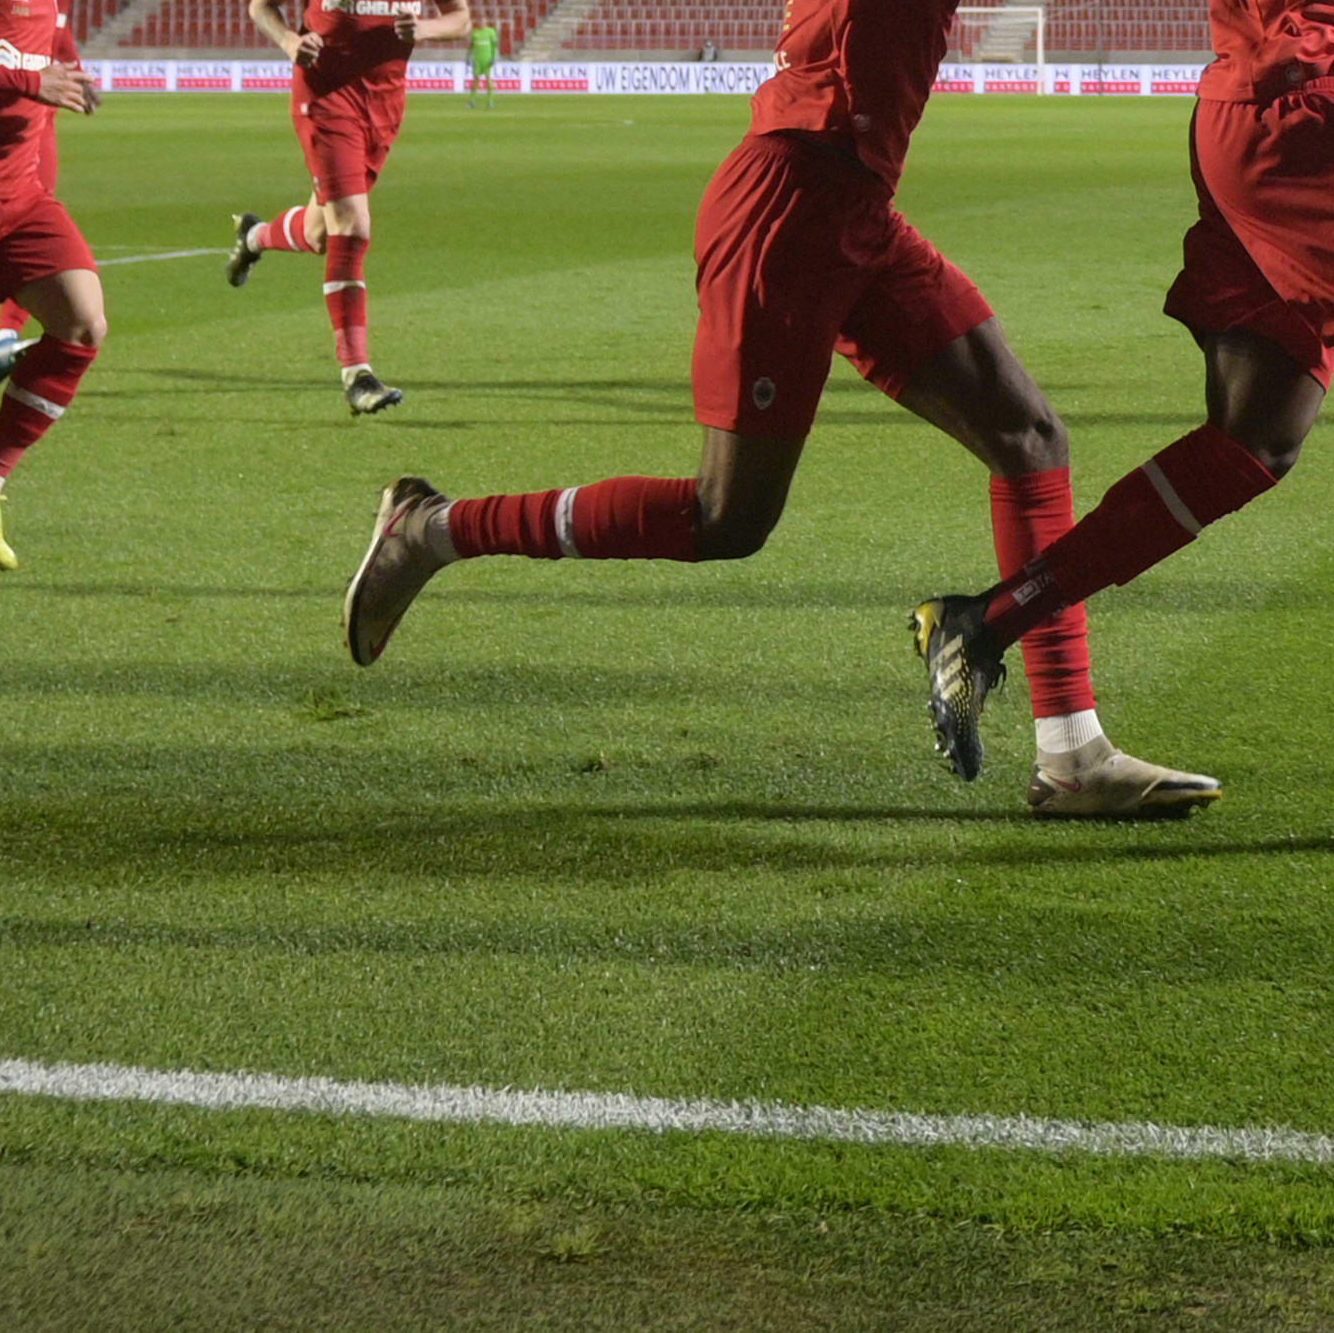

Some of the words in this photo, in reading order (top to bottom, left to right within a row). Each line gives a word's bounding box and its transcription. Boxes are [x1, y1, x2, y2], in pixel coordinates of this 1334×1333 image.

[112, 66, 166, 77] HEYLEN
[177, 66, 231, 77] HEYLEN
[531, 66, 587, 78] HEYLEN
[1081, 68, 1141, 80] HEYLEN
[595, 66, 616, 91] UW
[621, 66, 690, 91] EIGENDOM
